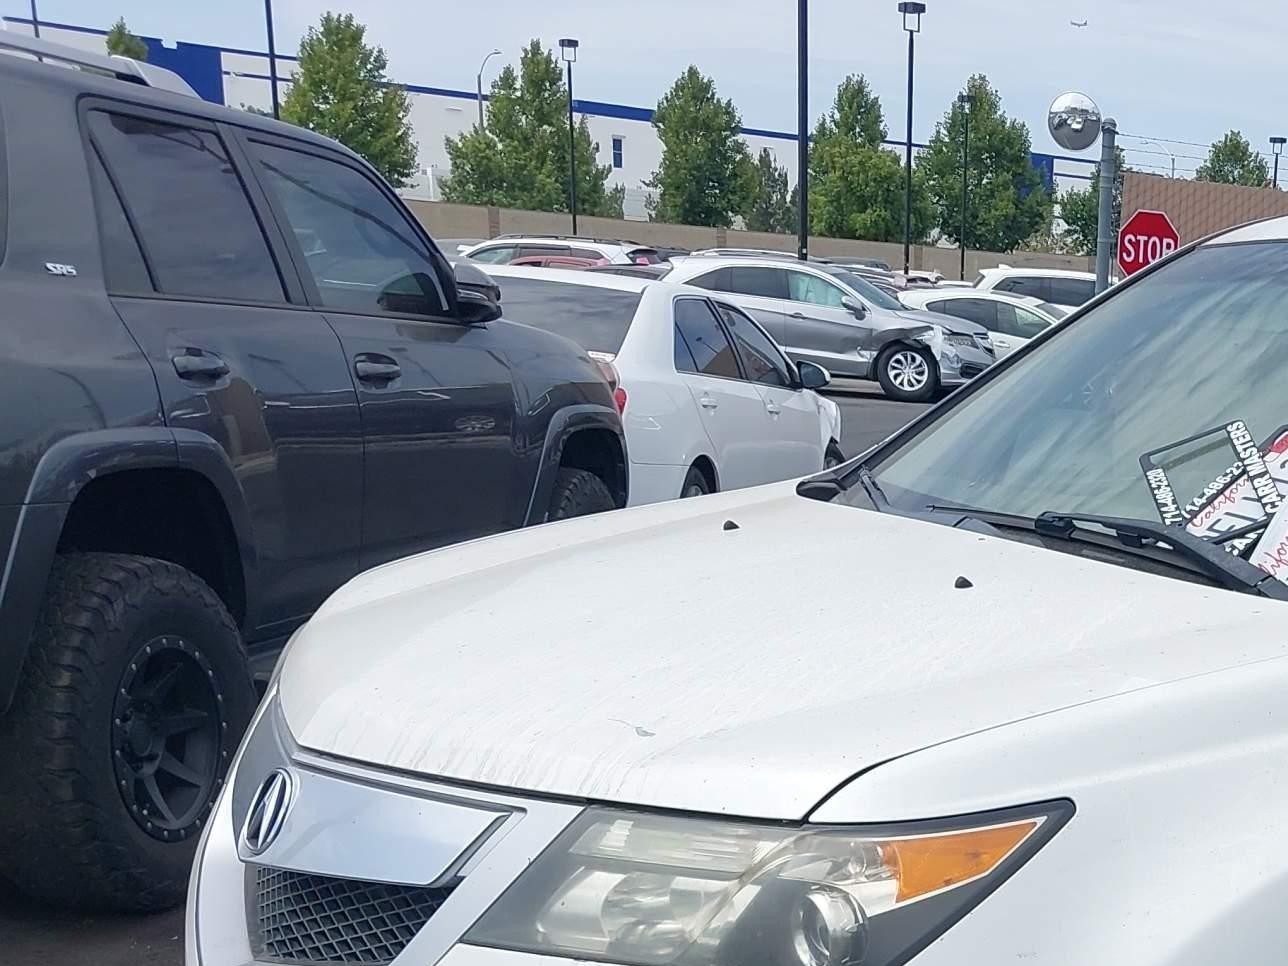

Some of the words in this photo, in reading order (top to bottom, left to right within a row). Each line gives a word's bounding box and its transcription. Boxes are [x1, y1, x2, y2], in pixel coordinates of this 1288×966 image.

[1122, 234, 1175, 264] STOP
[1226, 420, 1268, 478] MASTERS
[1252, 474, 1284, 514] CARR
